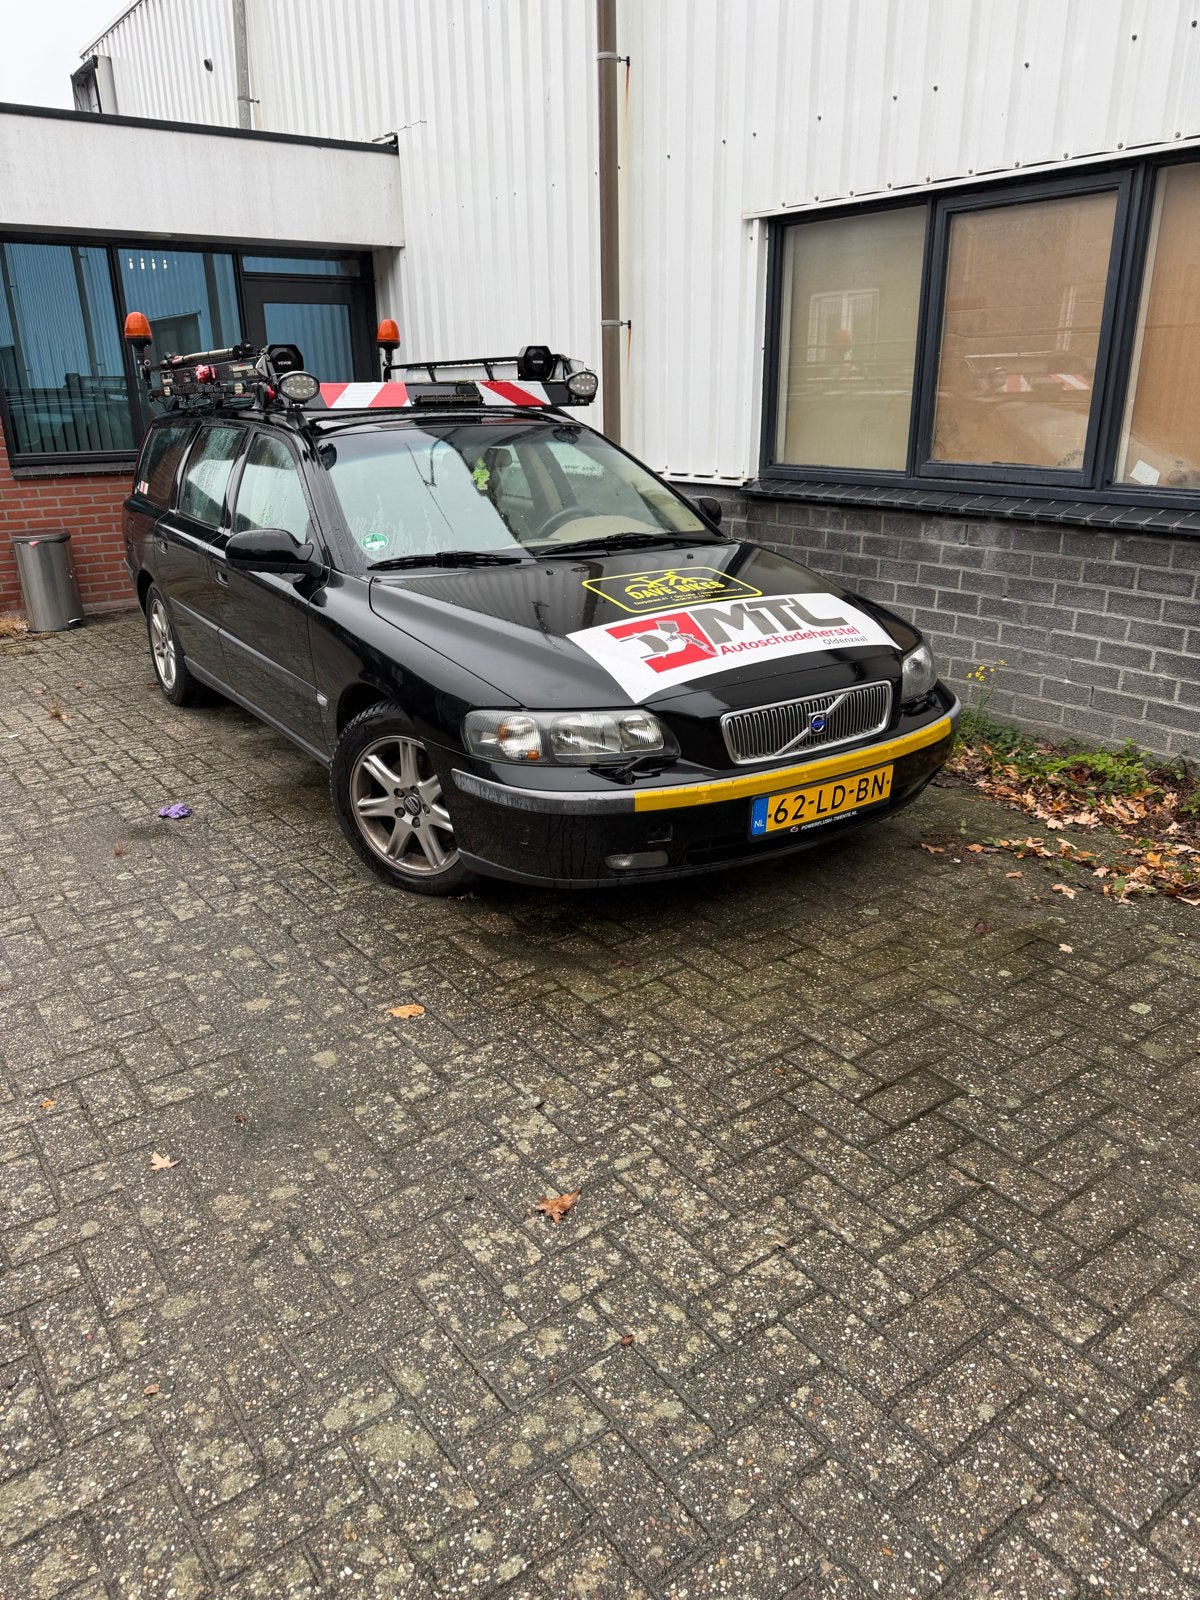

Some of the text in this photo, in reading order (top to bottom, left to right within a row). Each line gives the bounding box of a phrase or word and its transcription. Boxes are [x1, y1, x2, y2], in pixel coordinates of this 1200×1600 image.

[628, 586, 677, 600] DAVE
[673, 580, 725, 593] BIKES
[690, 598, 849, 645] MTL
[720, 626, 861, 656] Autoschadeherstel
[822, 635, 869, 646] Oldenzaal
[754, 819, 765, 828] NL
